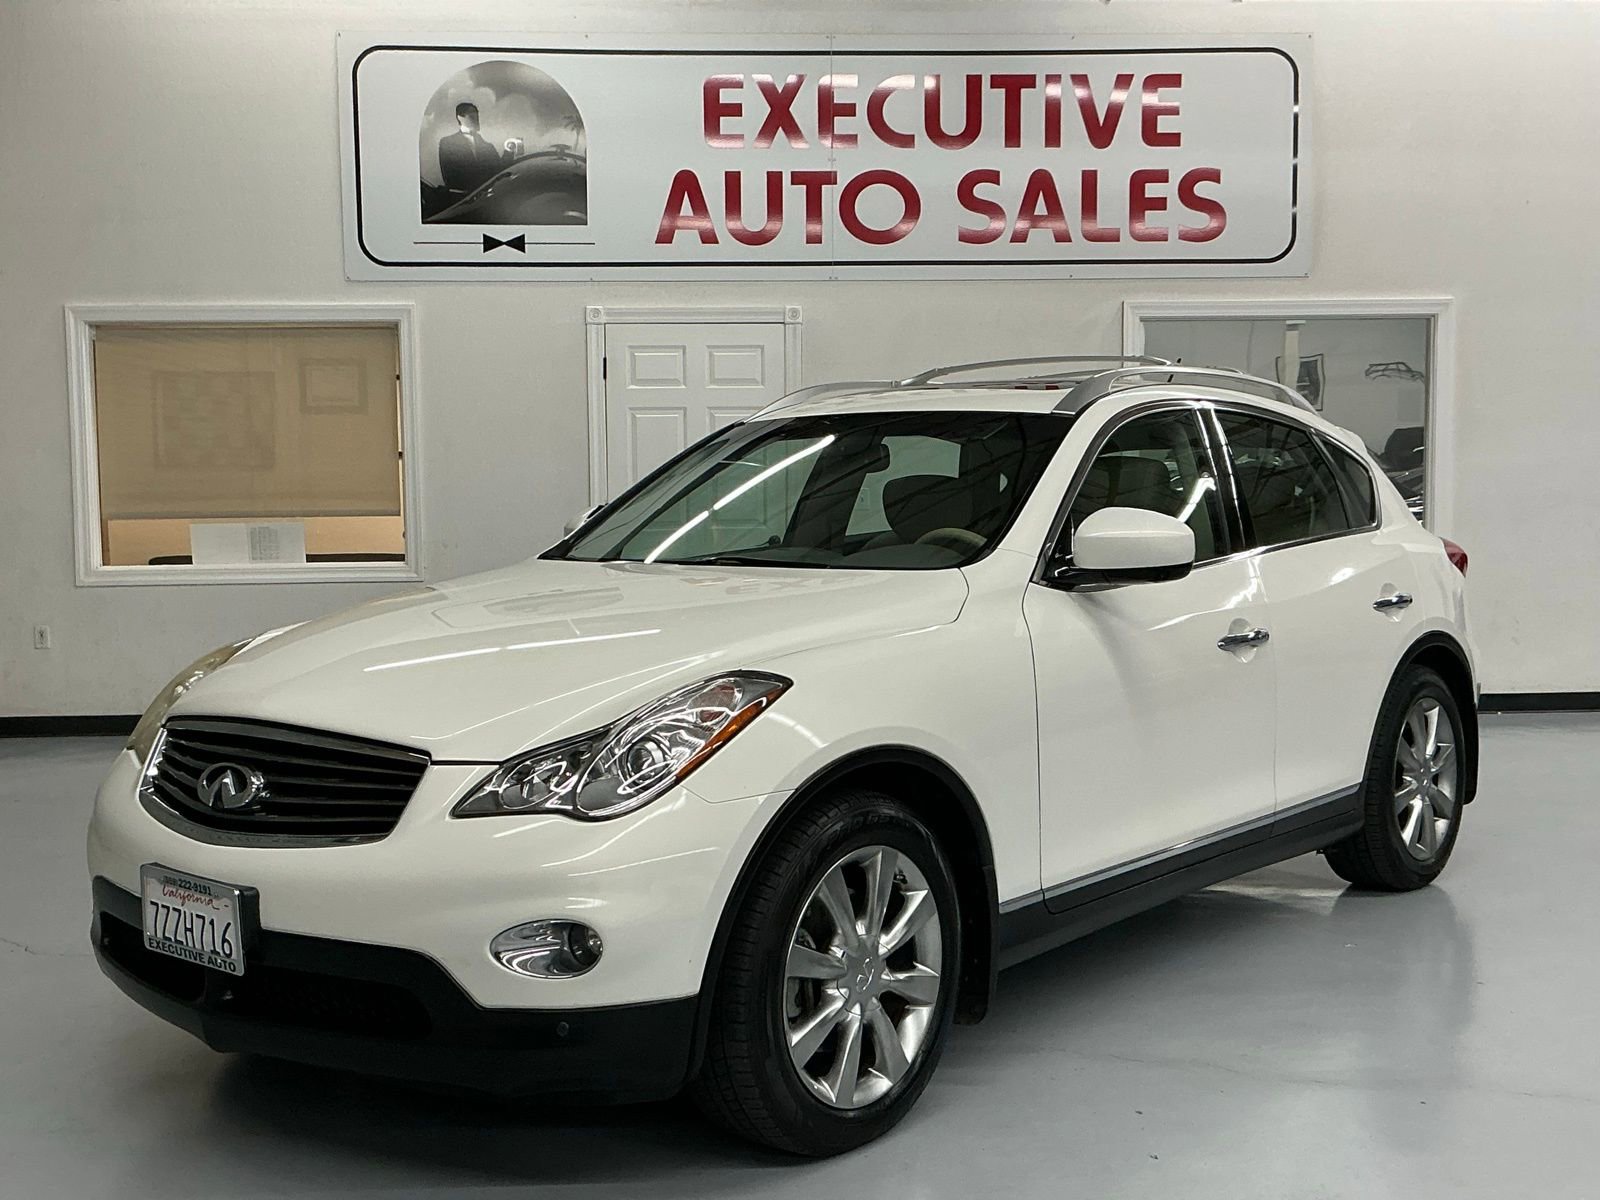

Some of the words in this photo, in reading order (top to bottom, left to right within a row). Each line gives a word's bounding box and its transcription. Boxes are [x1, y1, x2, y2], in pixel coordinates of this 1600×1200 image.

[703, 73, 1182, 149] EXECUTIVE
[655, 170, 921, 246] AUTO
[957, 168, 1226, 245] SALES
[148, 937, 206, 964] EXECUTIVE
[207, 956, 237, 973] AUTO
[149, 900, 233, 959] 7ZZH716
